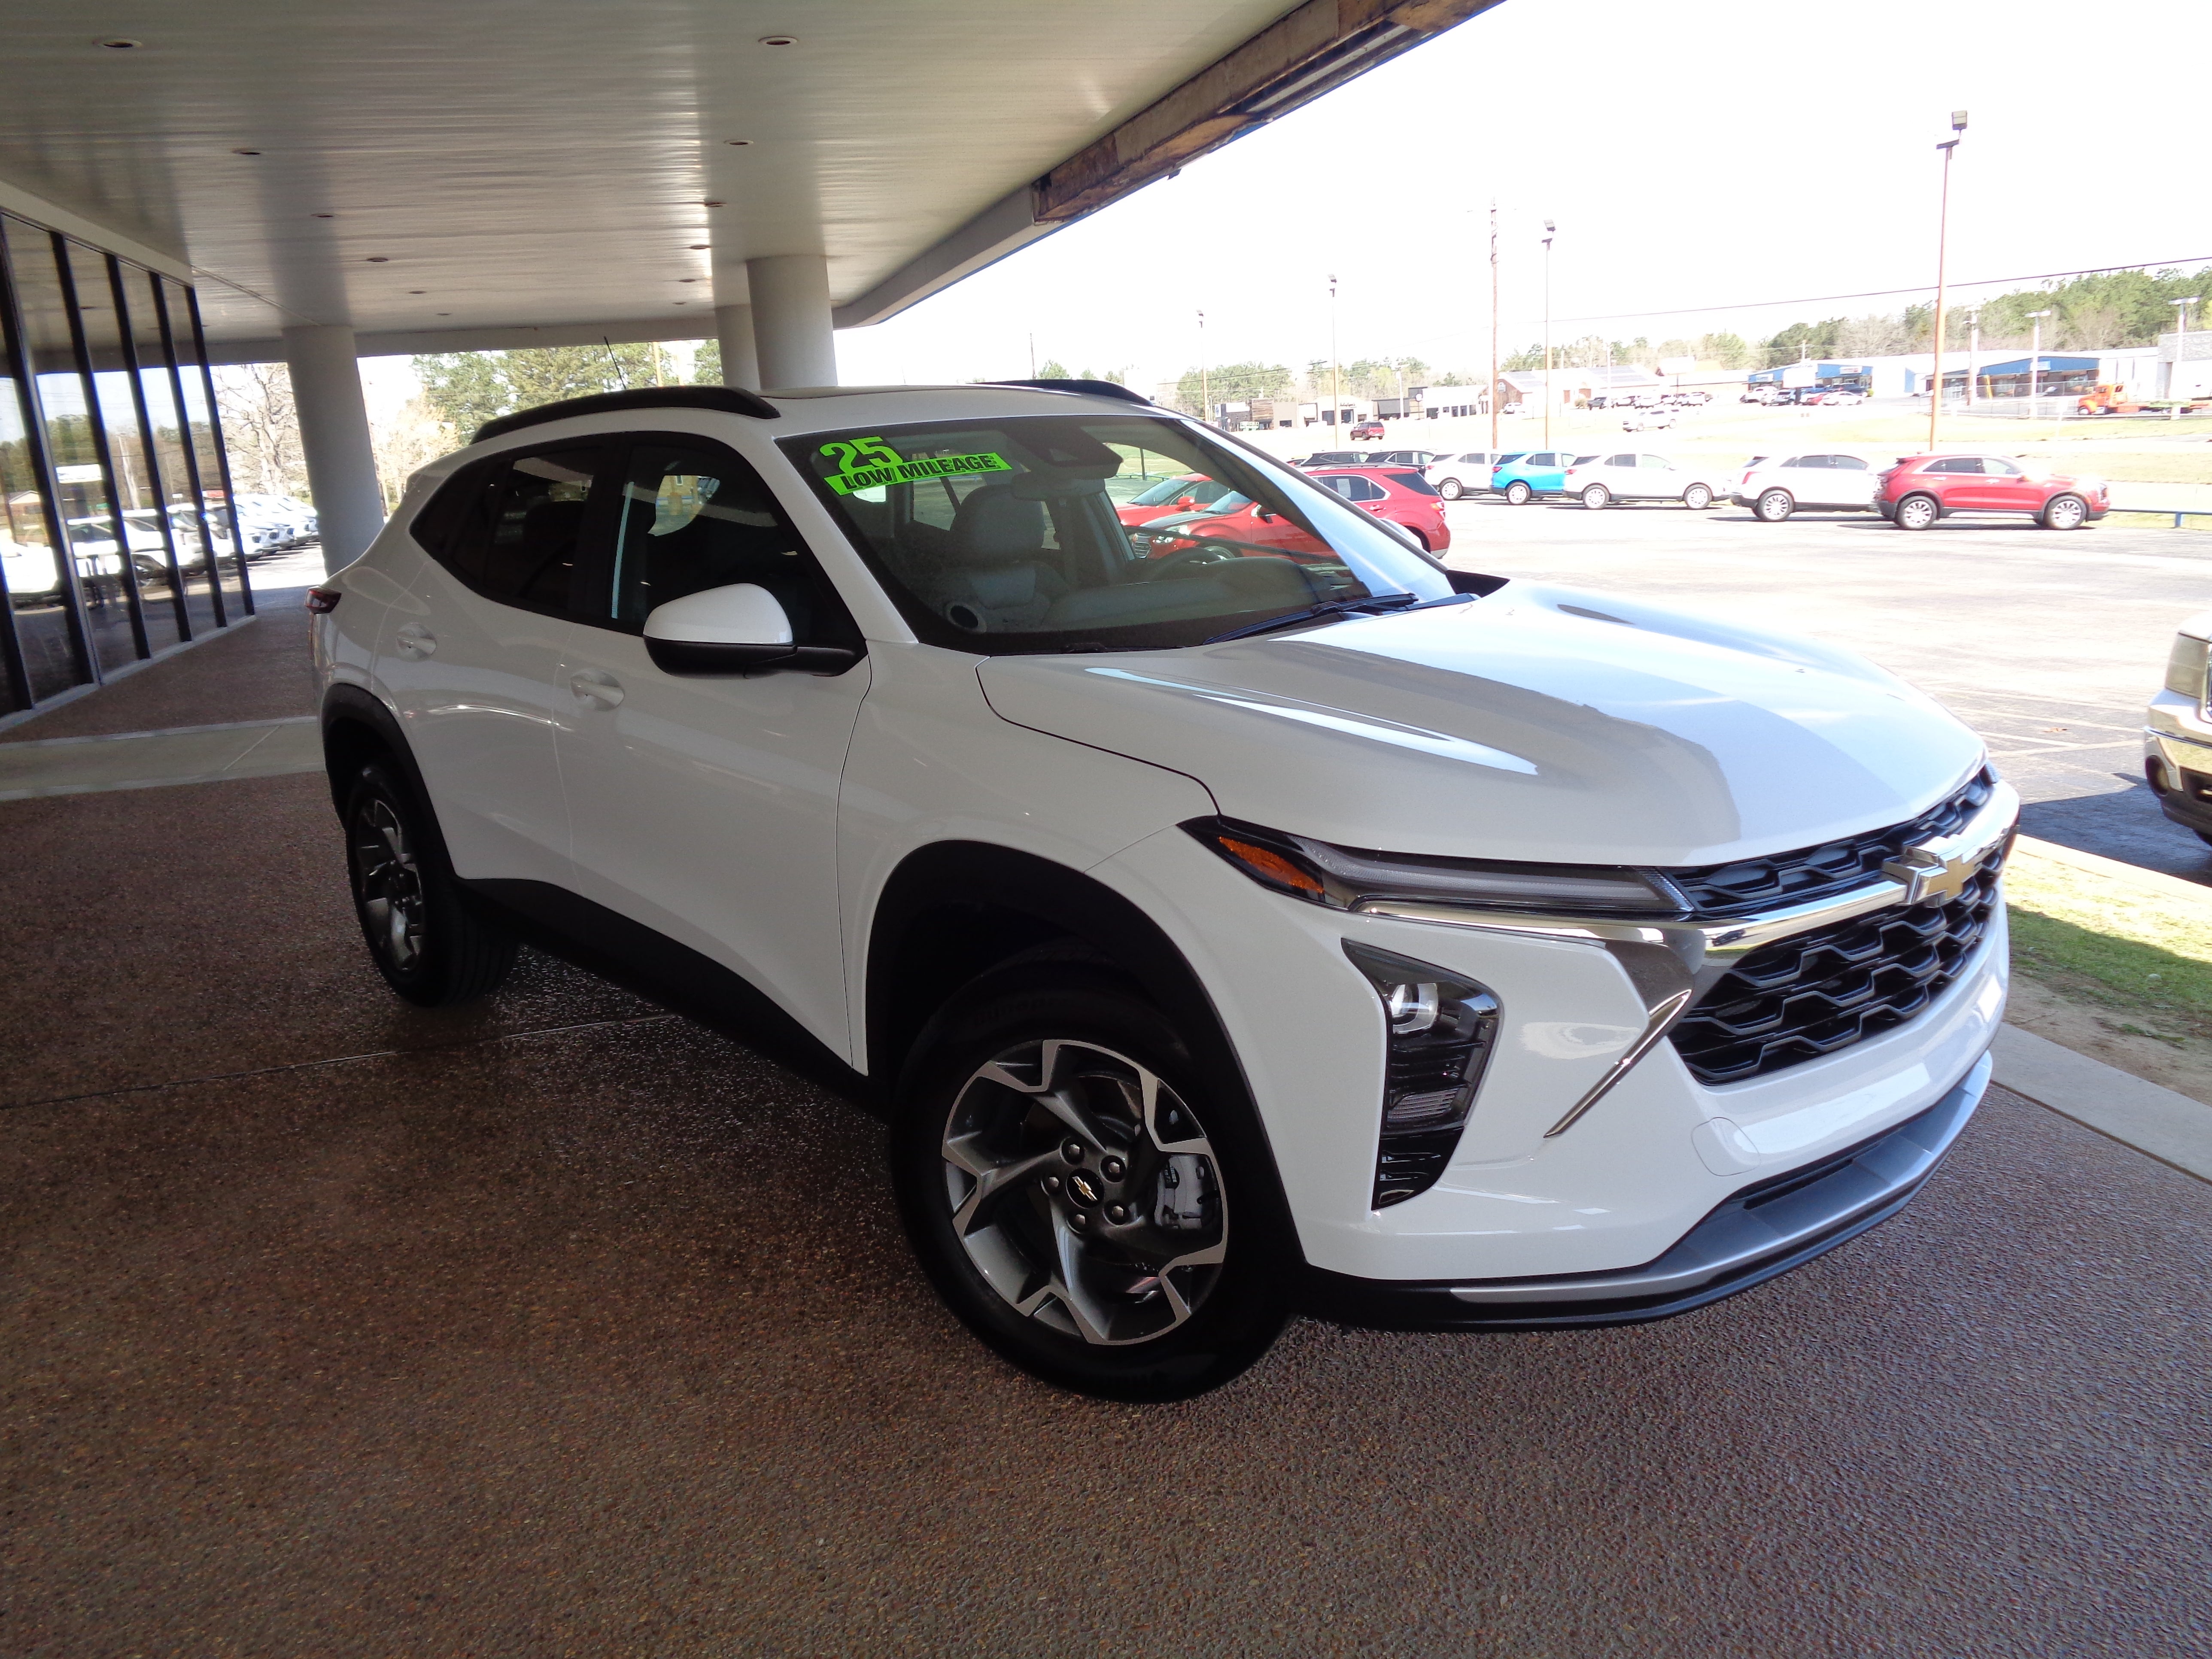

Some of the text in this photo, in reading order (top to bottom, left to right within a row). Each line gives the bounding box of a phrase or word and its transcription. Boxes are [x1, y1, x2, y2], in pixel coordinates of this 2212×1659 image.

[820, 436, 903, 474] 25
[840, 456, 998, 489] LOW MILEAGE
